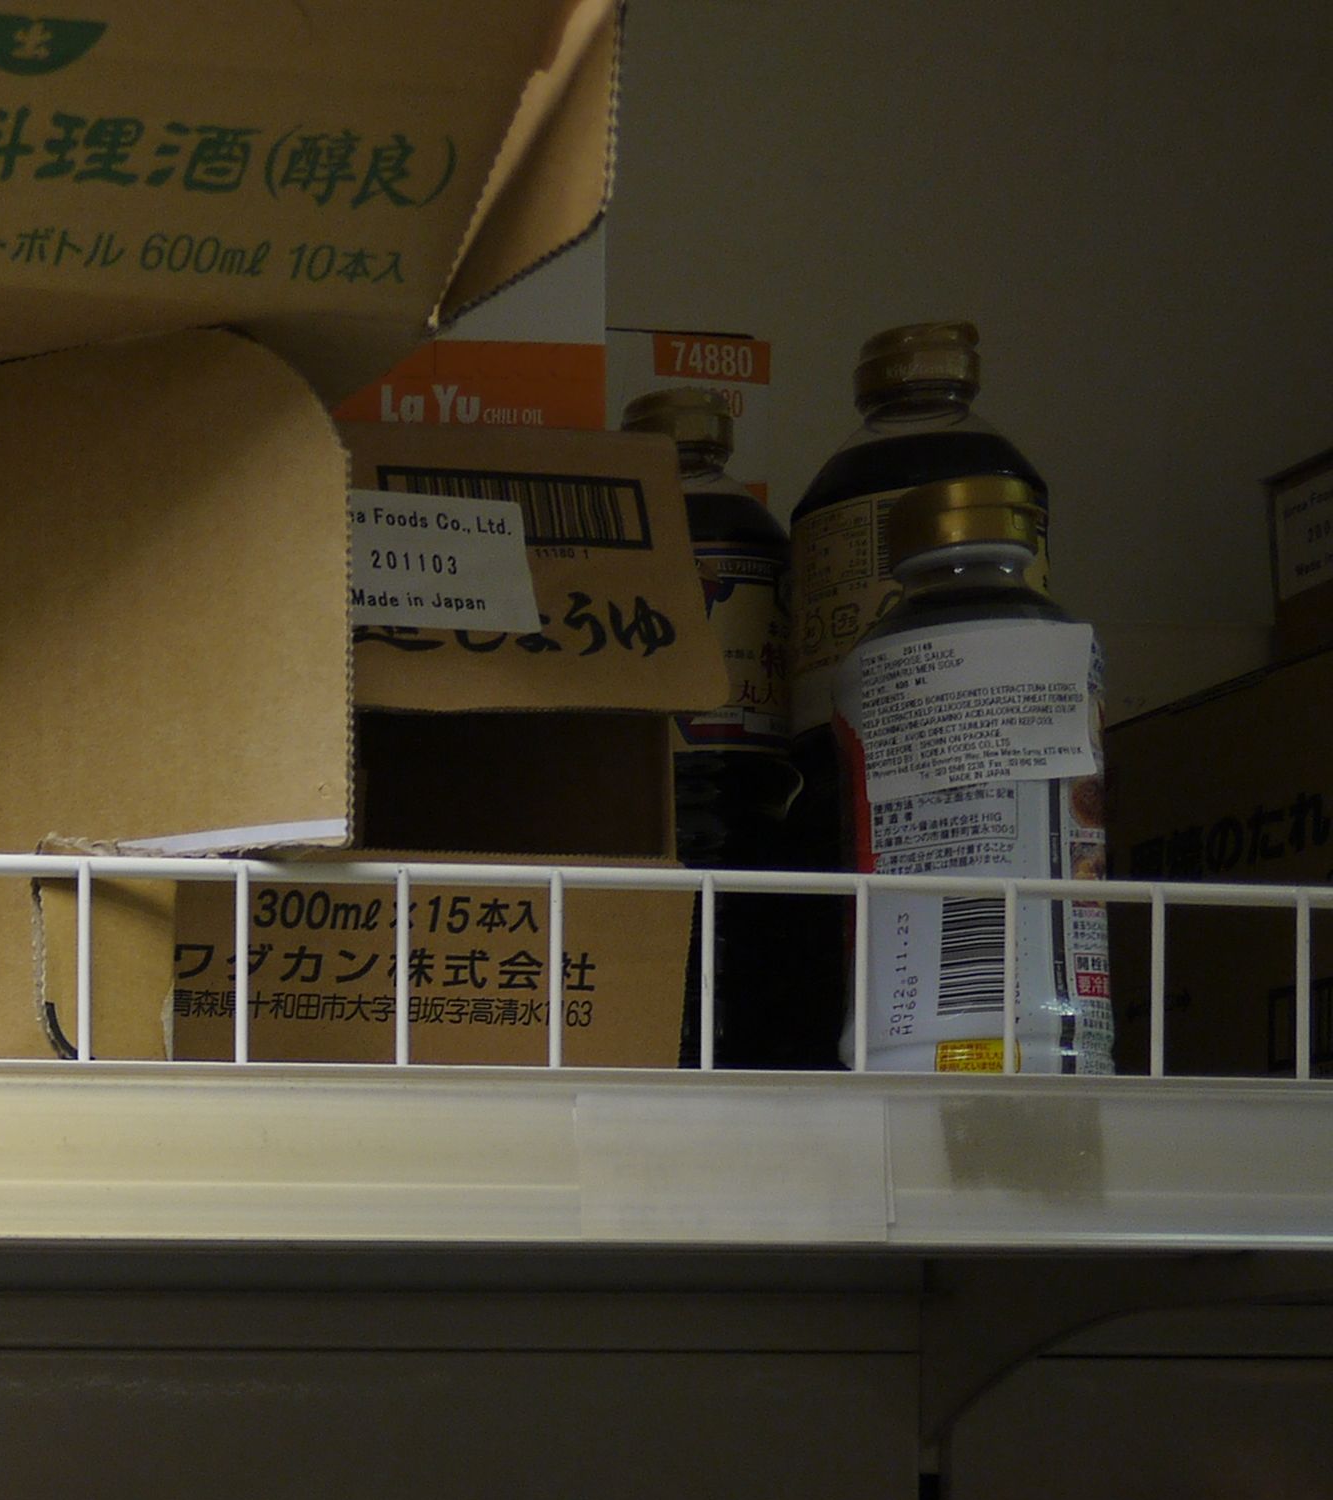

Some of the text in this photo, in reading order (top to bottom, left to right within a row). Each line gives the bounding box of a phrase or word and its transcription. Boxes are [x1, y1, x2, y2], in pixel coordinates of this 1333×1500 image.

[289, 242, 407, 284] 10本入
[671, 341, 753, 377] 74880
[380, 384, 543, 425] La Yu CHILI OIL
[374, 509, 512, 535] Foods Co., Ltd.
[371, 550, 458, 575] 201103
[351, 589, 486, 612] Made in Japan
